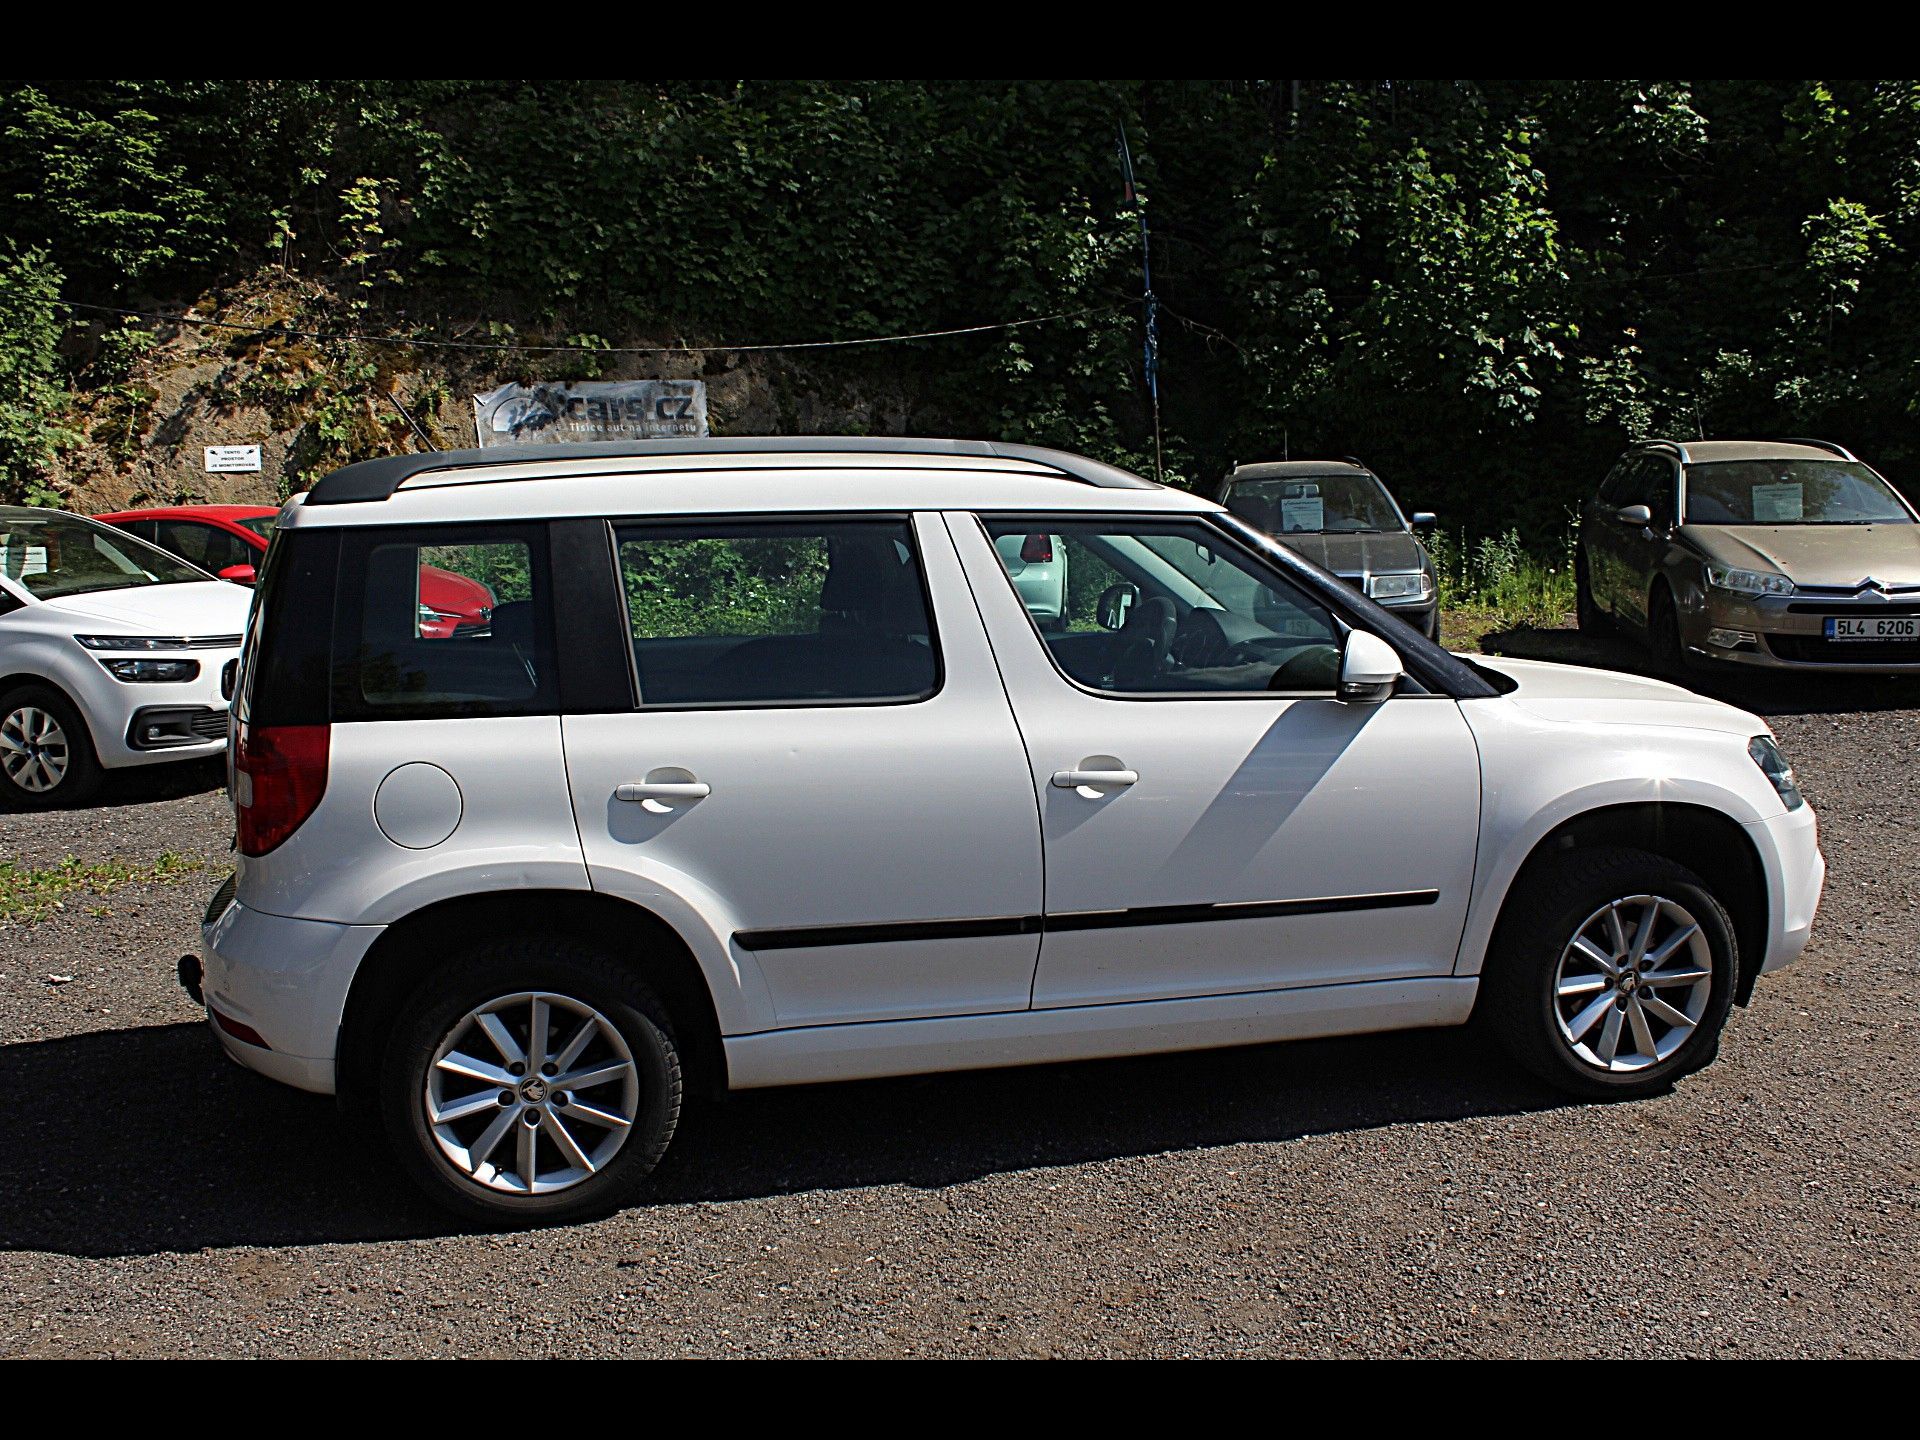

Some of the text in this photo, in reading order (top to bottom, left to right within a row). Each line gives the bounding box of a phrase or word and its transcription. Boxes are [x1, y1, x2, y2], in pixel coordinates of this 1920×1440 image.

[606, 423, 625, 432] aut
[629, 424, 642, 432] na
[645, 423, 696, 433] internetu
[1838, 620, 1914, 635] 5L4 6206
